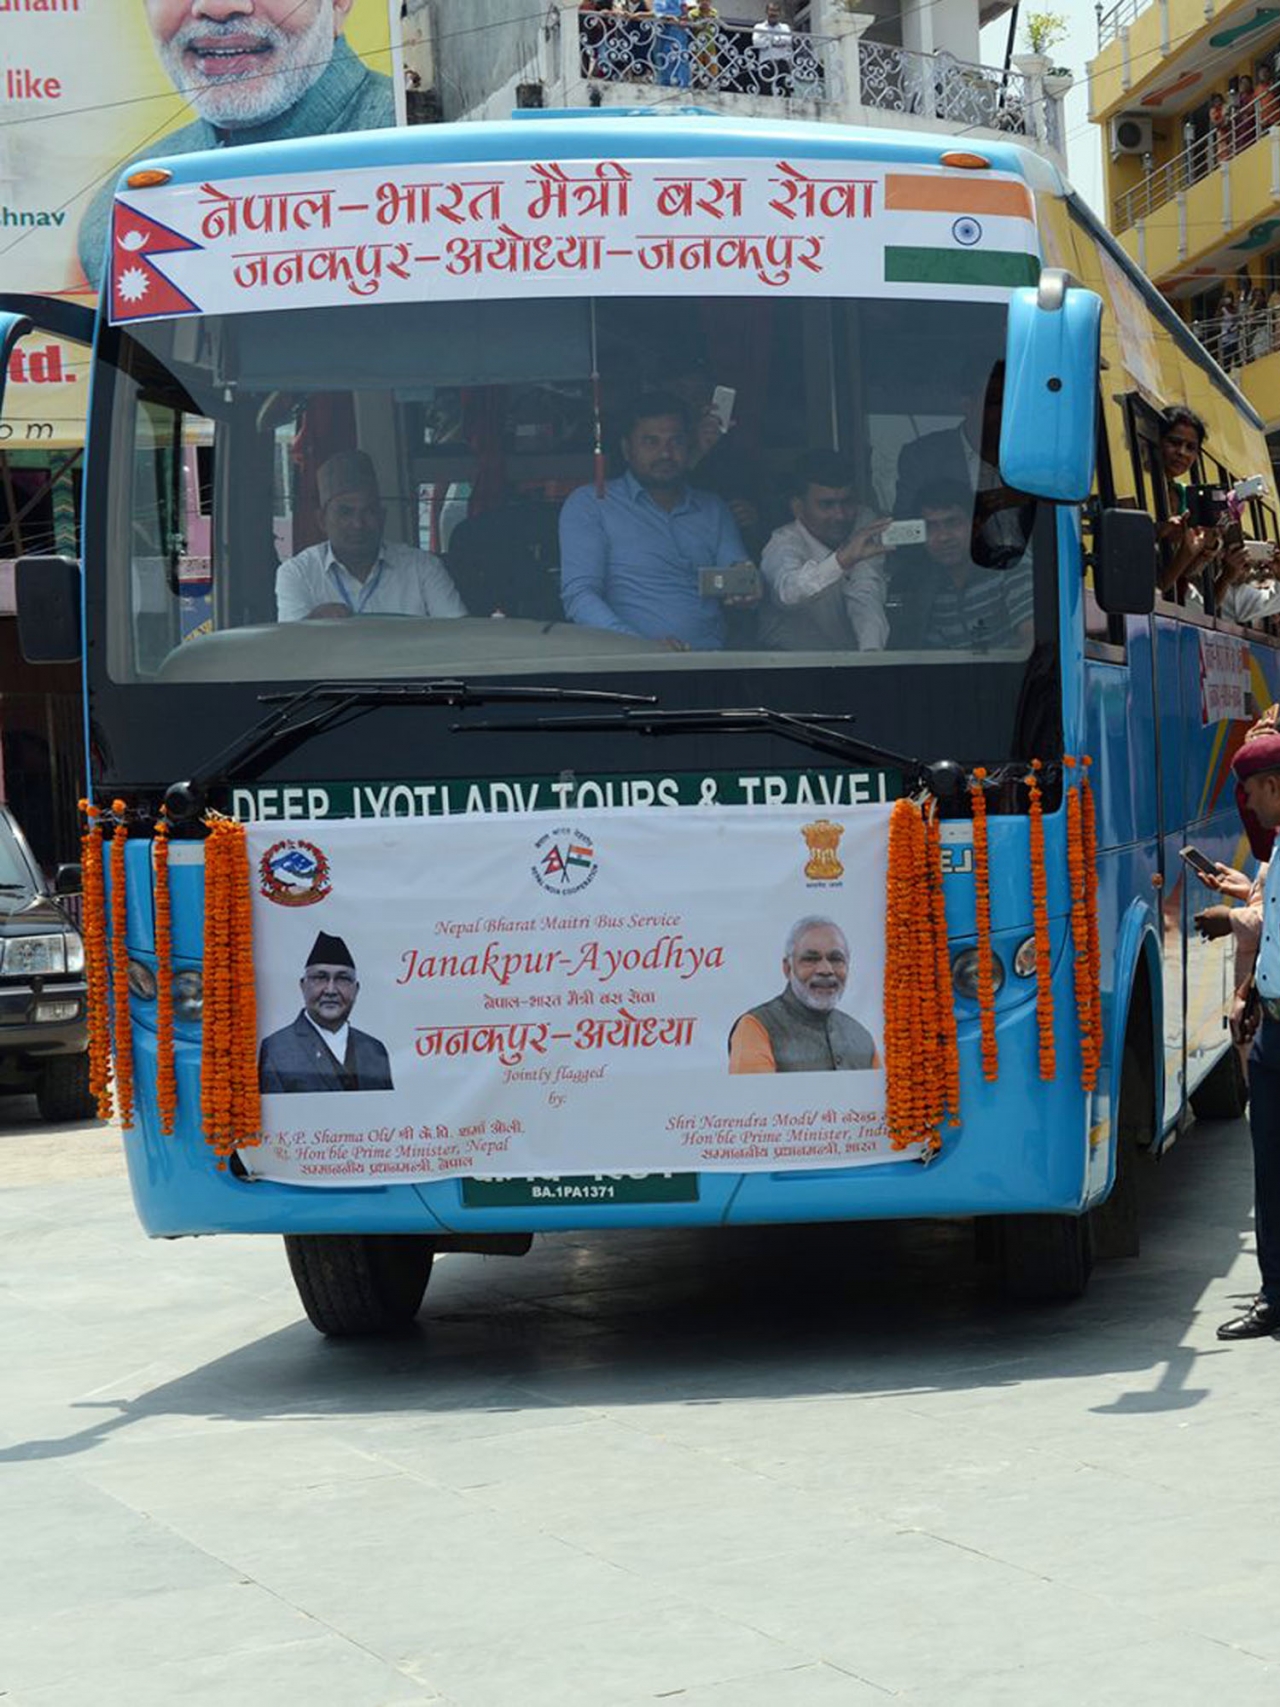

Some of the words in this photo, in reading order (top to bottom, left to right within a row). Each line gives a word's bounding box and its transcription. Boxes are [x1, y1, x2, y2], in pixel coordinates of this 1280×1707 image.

[7, 69, 61, 98] like
[198, 182, 505, 240] नेपाल-भारत
[526, 161, 632, 220] मैत्री
[653, 178, 747, 219] बस
[768, 161, 878, 220] सेवा
[0, 206, 65, 227] hnav
[8, 344, 77, 383] td.
[434, 918, 482, 938] Nepal
[484, 918, 536, 933] Bharat
[540, 916, 589, 931] Maitri
[595, 914, 623, 929] Bus
[627, 912, 682, 928] Service
[396, 935, 725, 985] Janakpur-Ayodhya
[414, 1007, 698, 1066] जनकपुर-अयोध्या
[503, 1066, 551, 1085] Jointly
[552, 1064, 608, 1084] flagged
[666, 1113, 696, 1130] Shri
[700, 1112, 768, 1130] Narendra
[311, 1128, 364, 1145] Sharma
[352, 1144, 391, 1160] Prime
[466, 1136, 511, 1156] Nepal
[741, 1130, 782, 1144] Prime
[532, 1185, 615, 1198] BA.1PA1371
